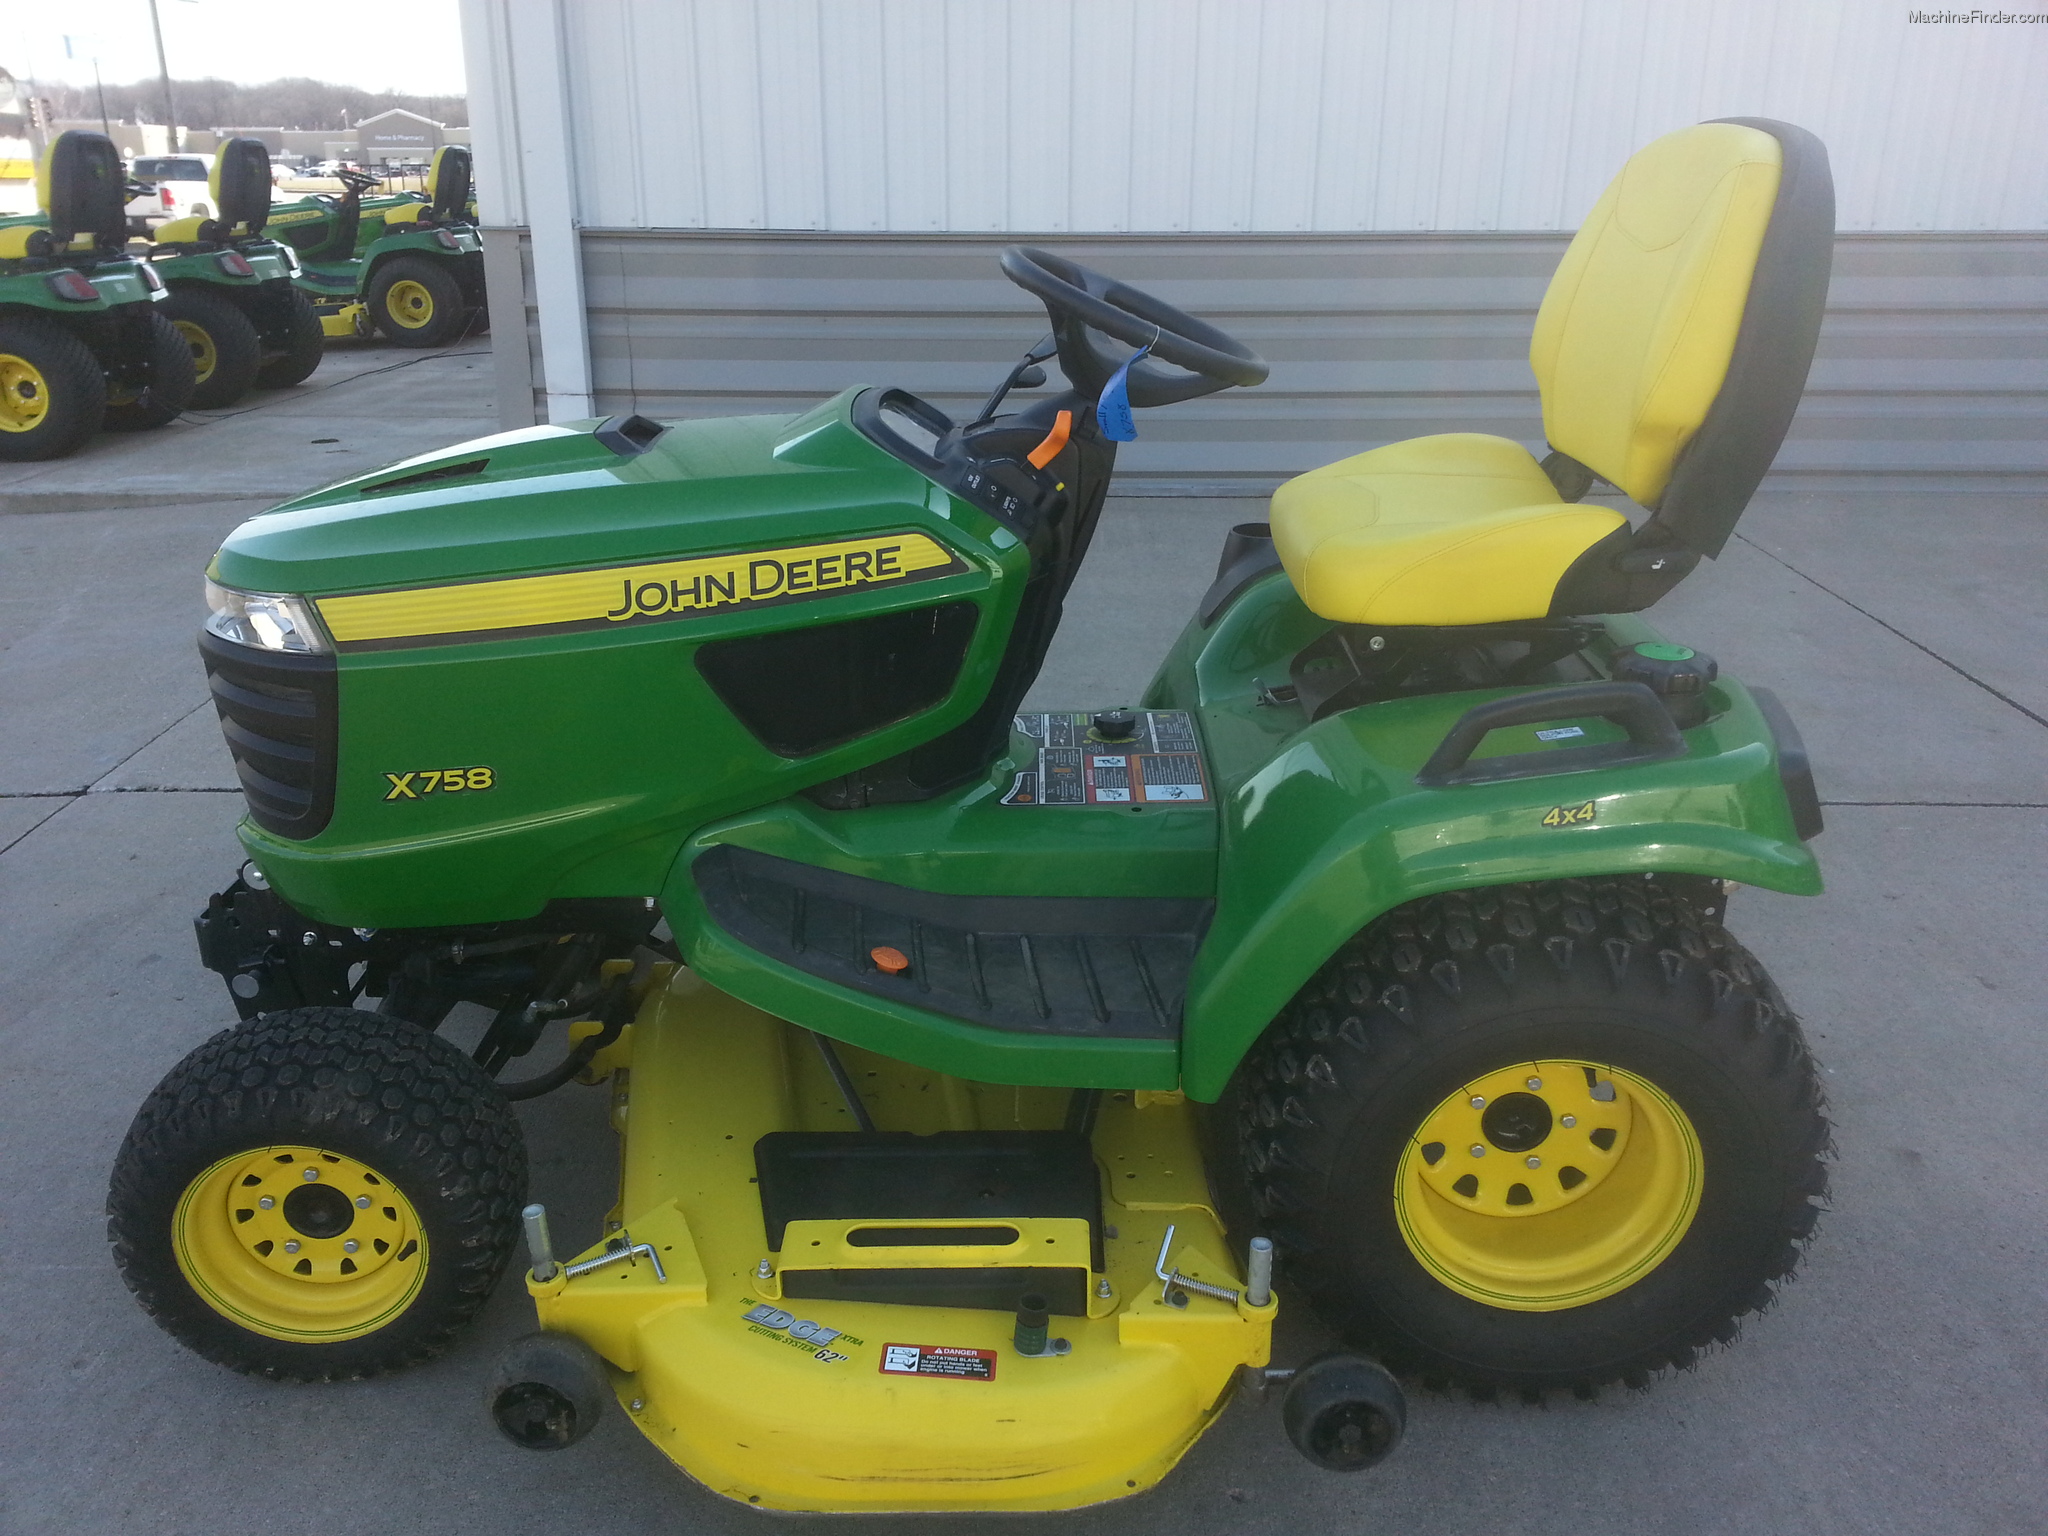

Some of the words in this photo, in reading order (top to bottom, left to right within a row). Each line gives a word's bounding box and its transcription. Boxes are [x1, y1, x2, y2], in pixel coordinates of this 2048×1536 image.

[397, 134, 424, 142] Pharmacy
[607, 570, 738, 619] JOHN
[748, 545, 904, 598] DEERE
[384, 767, 494, 801] X758
[1542, 801, 1596, 828] 4x4
[739, 1297, 757, 1307] THE
[741, 1303, 843, 1347] EDGE
[840, 1334, 865, 1347] XTRA
[748, 1325, 783, 1342] CUTTING
[781, 1336, 818, 1353] SYSTEM
[813, 1348, 850, 1364] 62"
[926, 1354, 958, 1362] ROTATING
[943, 1348, 978, 1356] DANGER
